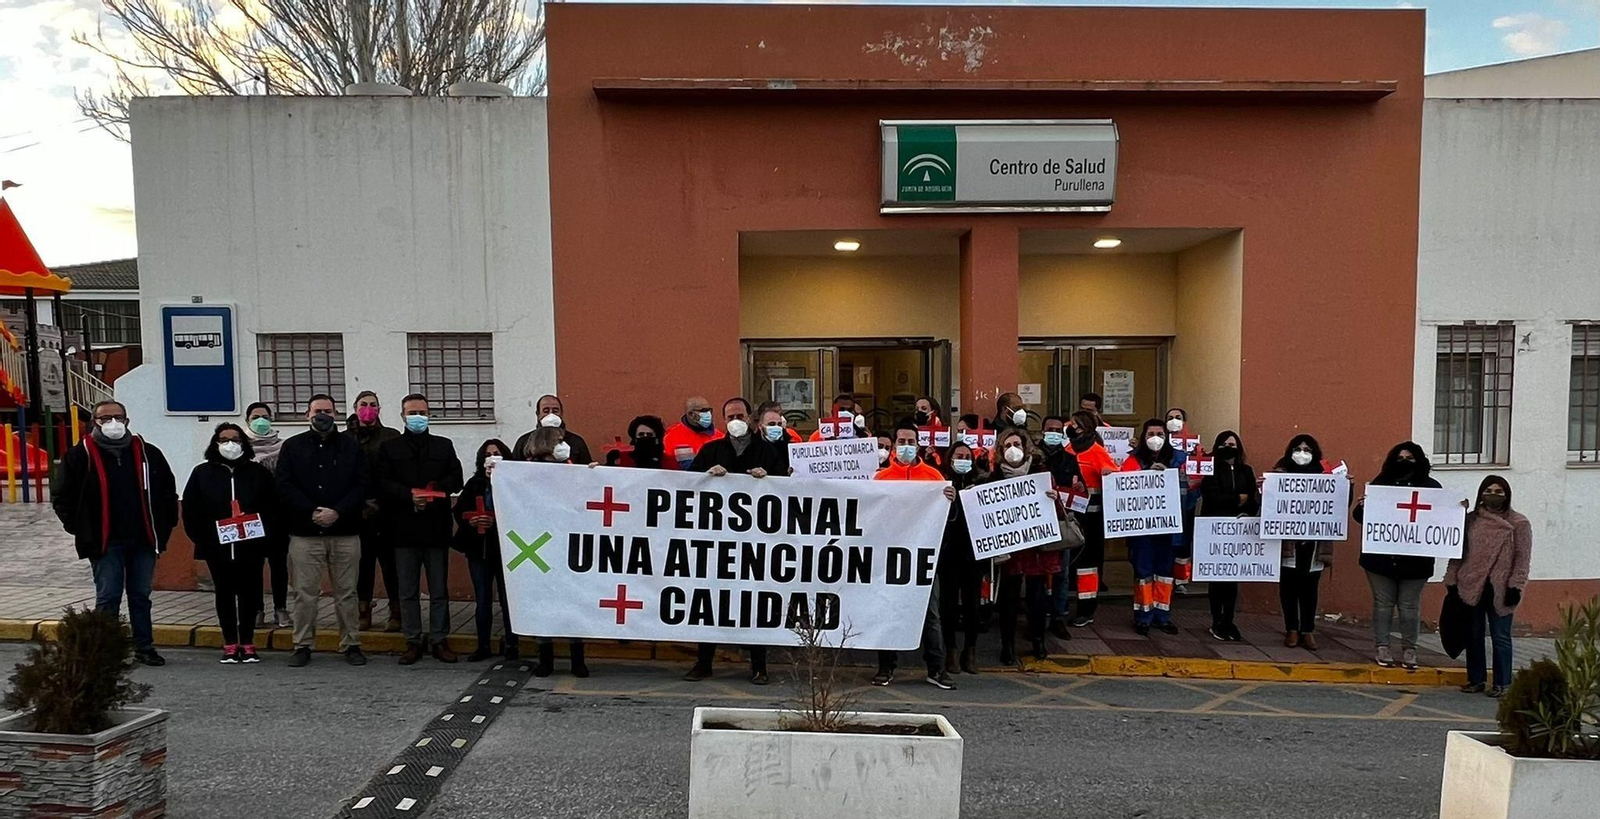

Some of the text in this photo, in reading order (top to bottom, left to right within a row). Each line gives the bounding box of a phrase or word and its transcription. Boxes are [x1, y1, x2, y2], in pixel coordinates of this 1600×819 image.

[989, 158, 1105, 175] Centro de Salud
[1054, 178, 1104, 191] Purullena
[792, 442, 874, 458] PURULLENA Y SU COMARCA
[808, 460, 860, 474] NECESITAN TODA
[1115, 474, 1165, 491] NECESITAMOS
[1278, 478, 1336, 493] NECESITAMOS
[976, 479, 1036, 506] NECESITAMOS
[645, 488, 863, 537] PERSONAL
[1115, 495, 1166, 513] UN EQUIPO DE
[1276, 500, 1334, 515] UN EQUIPO DE
[982, 512, 996, 529] UN
[997, 505, 1028, 526] EQUIPO
[1028, 502, 1041, 519] DE
[1107, 515, 1180, 533] REFUERZO MATINAL
[1211, 522, 1260, 535] NECESITAMO
[1263, 521, 1344, 536] REFUERZO MATINAL
[1366, 522, 1460, 546] PERSONAL COVID
[975, 522, 1058, 553] REFUERZO MATINAL
[1209, 542, 1265, 558] UN EQUIPO DE
[567, 533, 935, 586] UNA ATENCIÓN DE
[1198, 562, 1275, 576] REFUERZO MATINAL
[659, 586, 841, 630] CALIDAD
